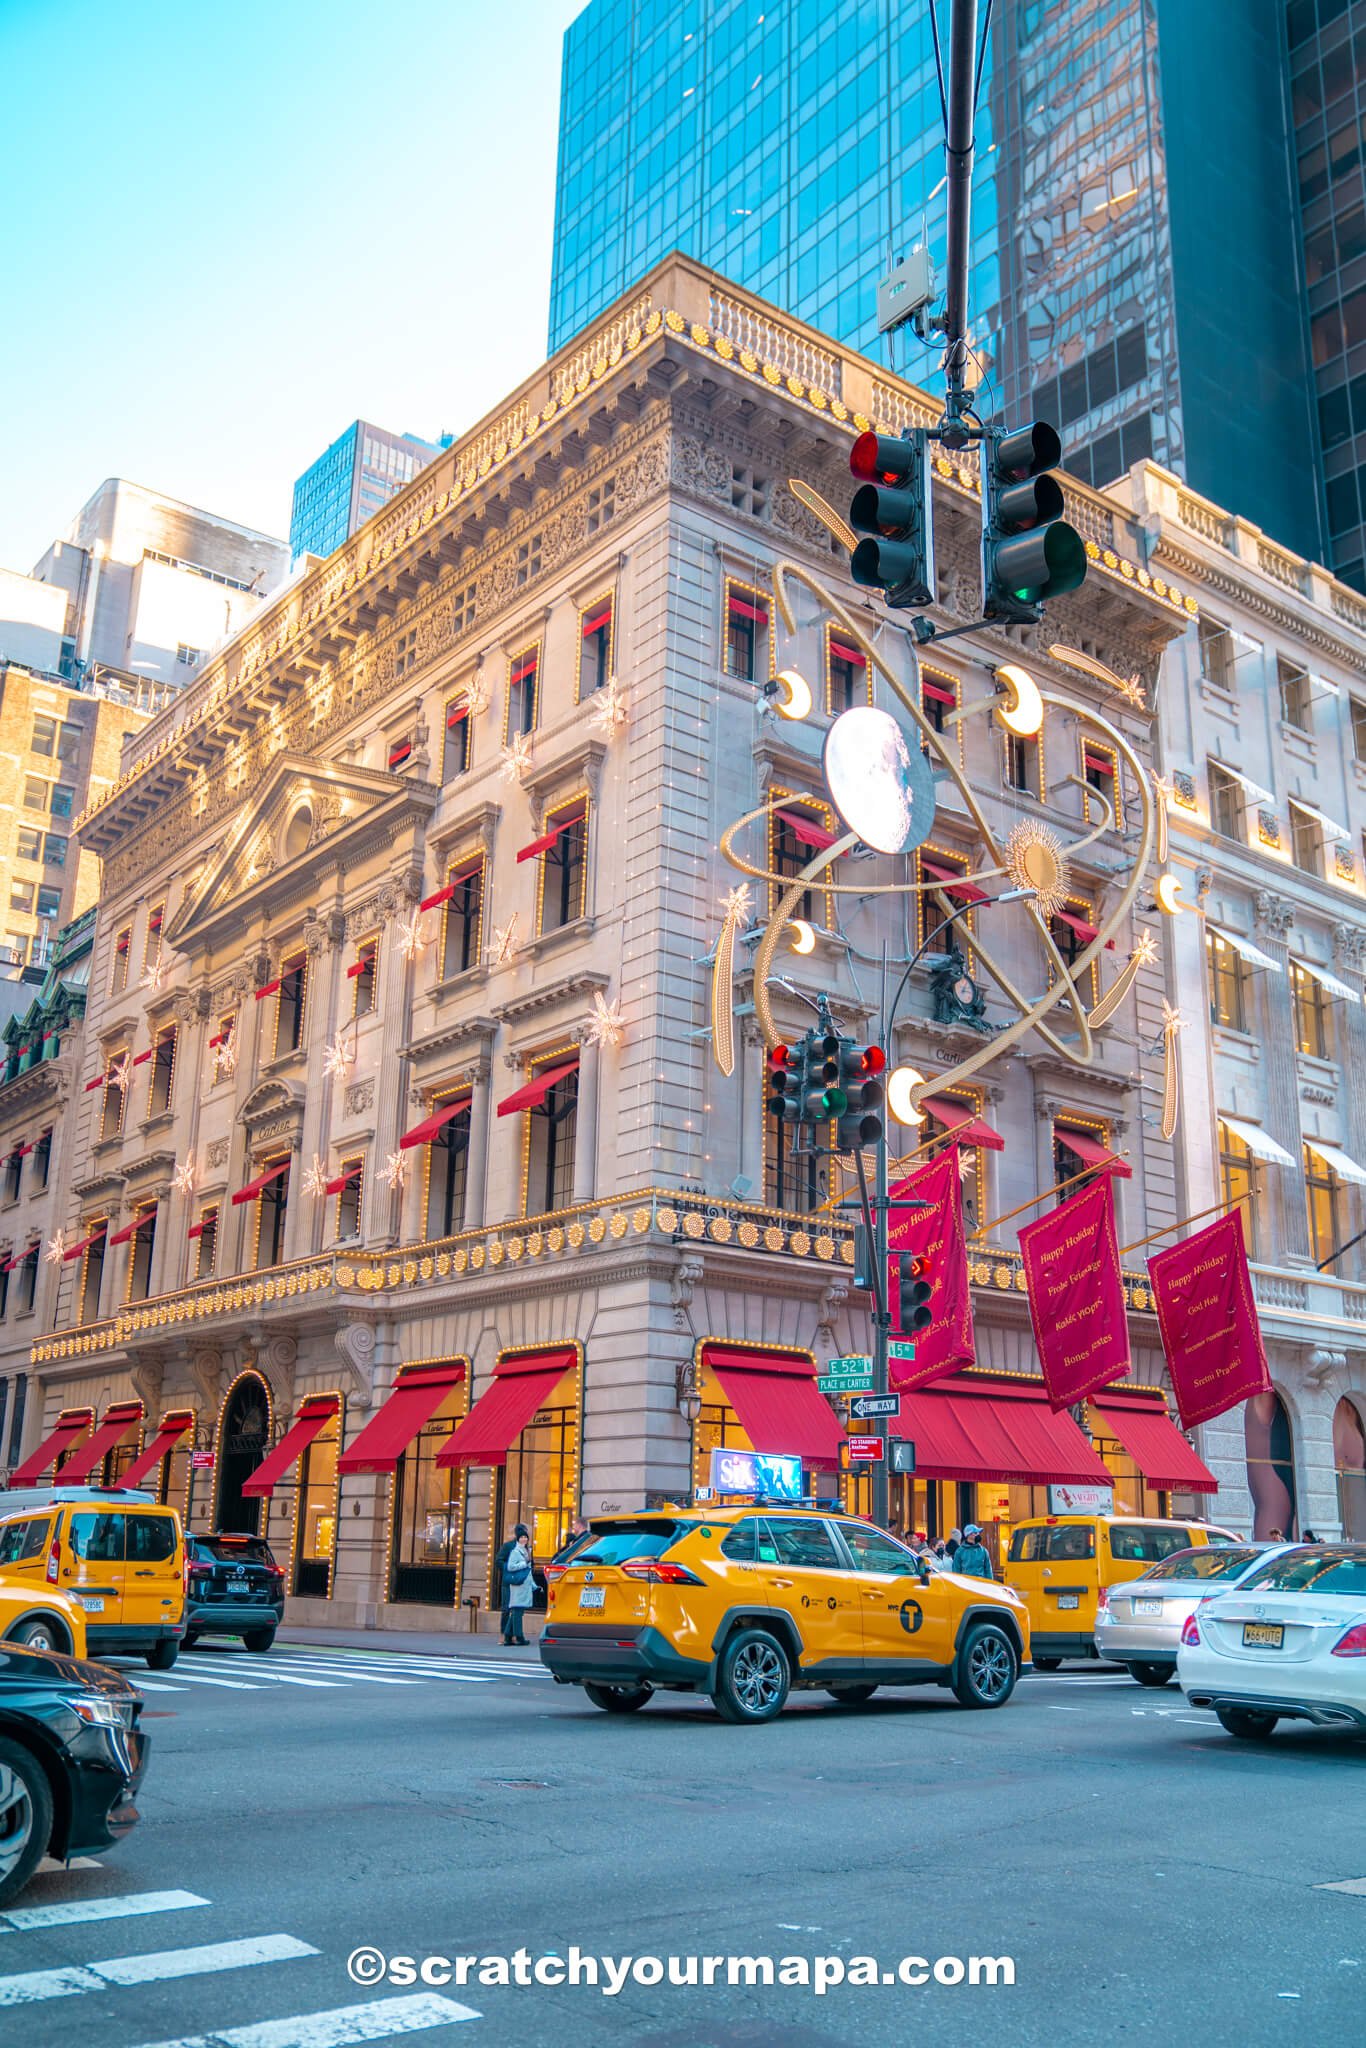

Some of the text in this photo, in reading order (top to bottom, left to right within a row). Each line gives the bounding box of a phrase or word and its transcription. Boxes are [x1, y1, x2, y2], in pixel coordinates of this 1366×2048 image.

[259, 1119, 290, 1139] Cartier
[1040, 1244, 1065, 1265] Happy
[1167, 1273, 1192, 1290] Happy
[1187, 1303, 1204, 1316] God
[898, 1345, 904, 1356] 5
[1063, 1350, 1090, 1367] Bones
[831, 1362, 838, 1373] E
[842, 1360, 857, 1373] 52
[820, 1380, 838, 1390] PLACE
[847, 1378, 870, 1388] CARTIER
[858, 1400, 893, 1413] ONE WAY
[601, 1501, 621, 1512] Cartier
